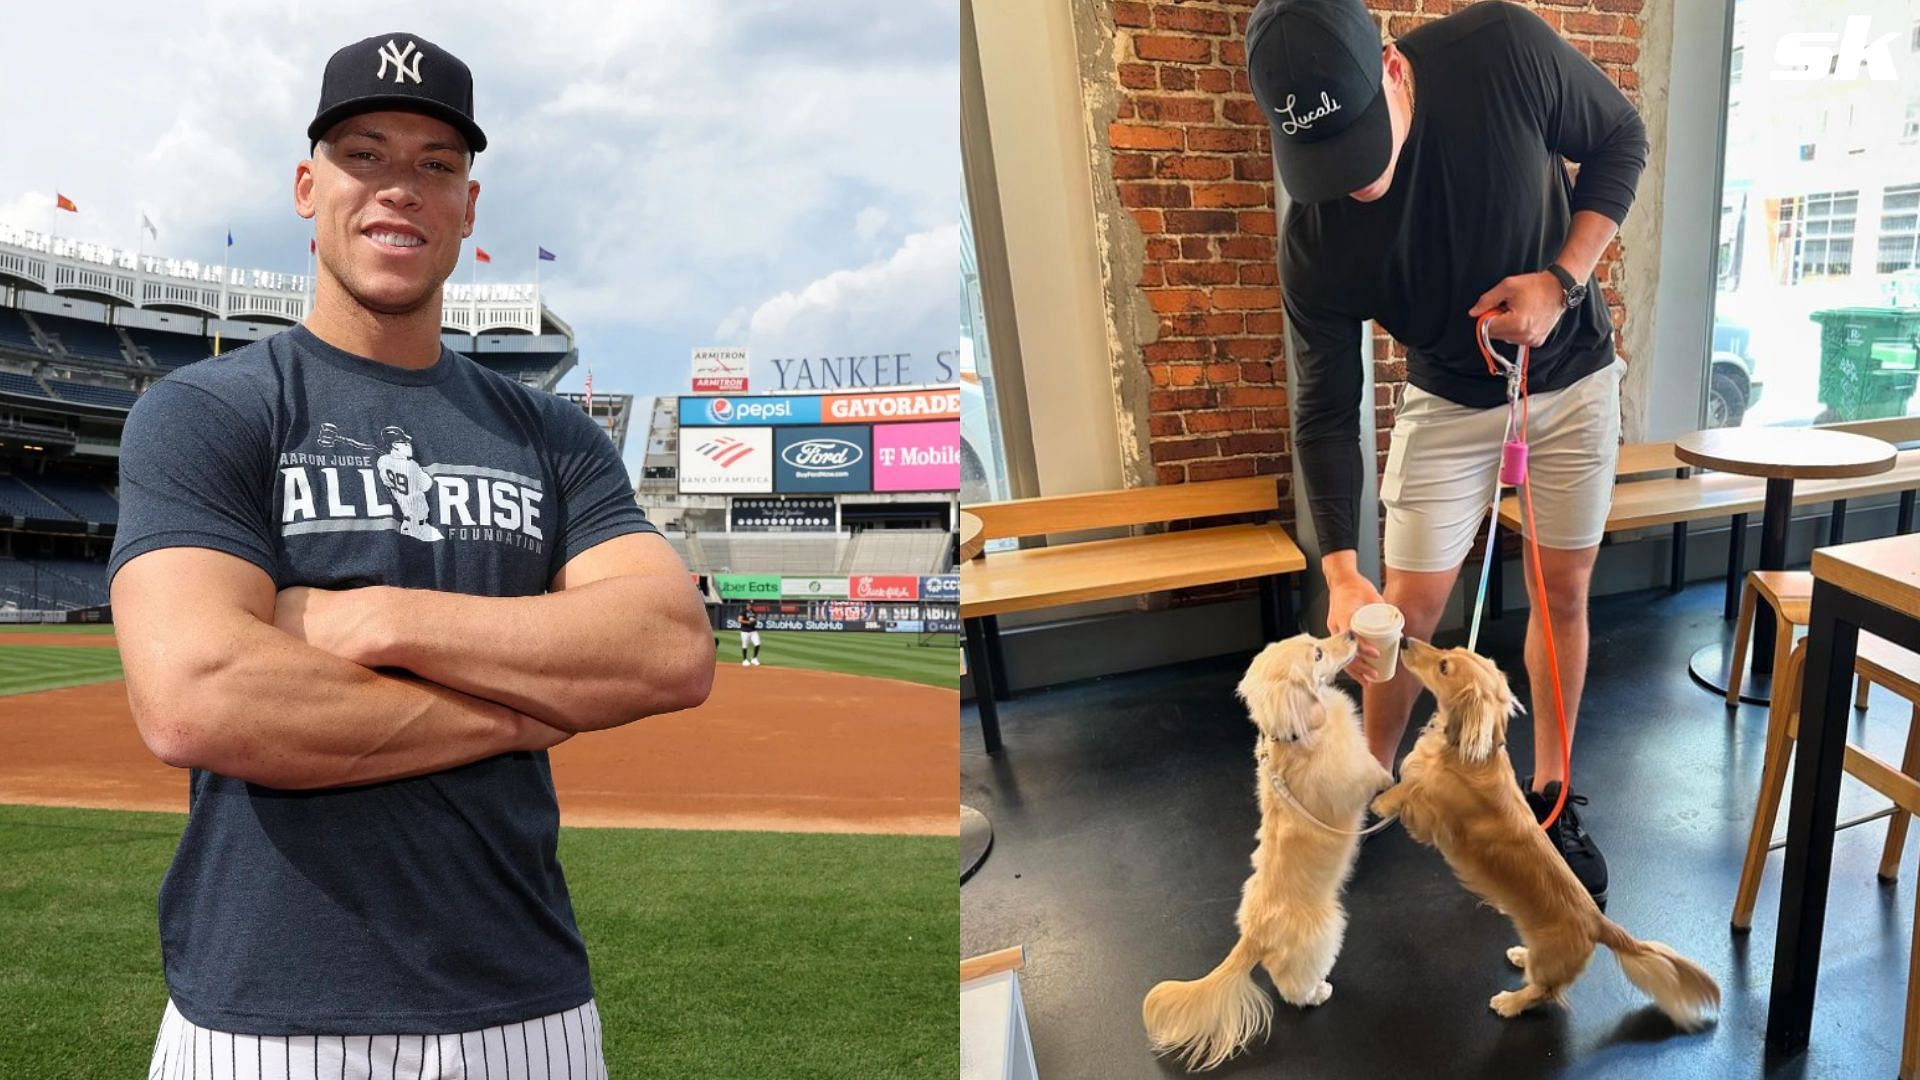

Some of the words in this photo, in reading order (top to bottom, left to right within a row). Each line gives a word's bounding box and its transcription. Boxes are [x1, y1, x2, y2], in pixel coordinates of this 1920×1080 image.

[1273, 91, 1342, 135] Lucali
[694, 351, 746, 359] ARMITRON
[771, 353, 912, 390] YANKEE
[935, 349, 960, 384] S
[696, 378, 744, 387] ARMITRON
[737, 400, 790, 420] pepsi
[831, 393, 960, 418] GATORADE
[279, 452, 327, 466] AARON
[330, 454, 372, 467] JUDGE
[795, 442, 848, 465] Ford
[681, 476, 707, 484] BANK
[710, 476, 722, 484] OF
[725, 476, 769, 484] AMERICA
[280, 467, 393, 522] ALL
[433, 476, 544, 540] RISE
[448, 528, 543, 554] FOUNDATION
[748, 581, 778, 592] Eats
[766, 620, 803, 630] StubHub
[806, 620, 843, 631] StubHub
